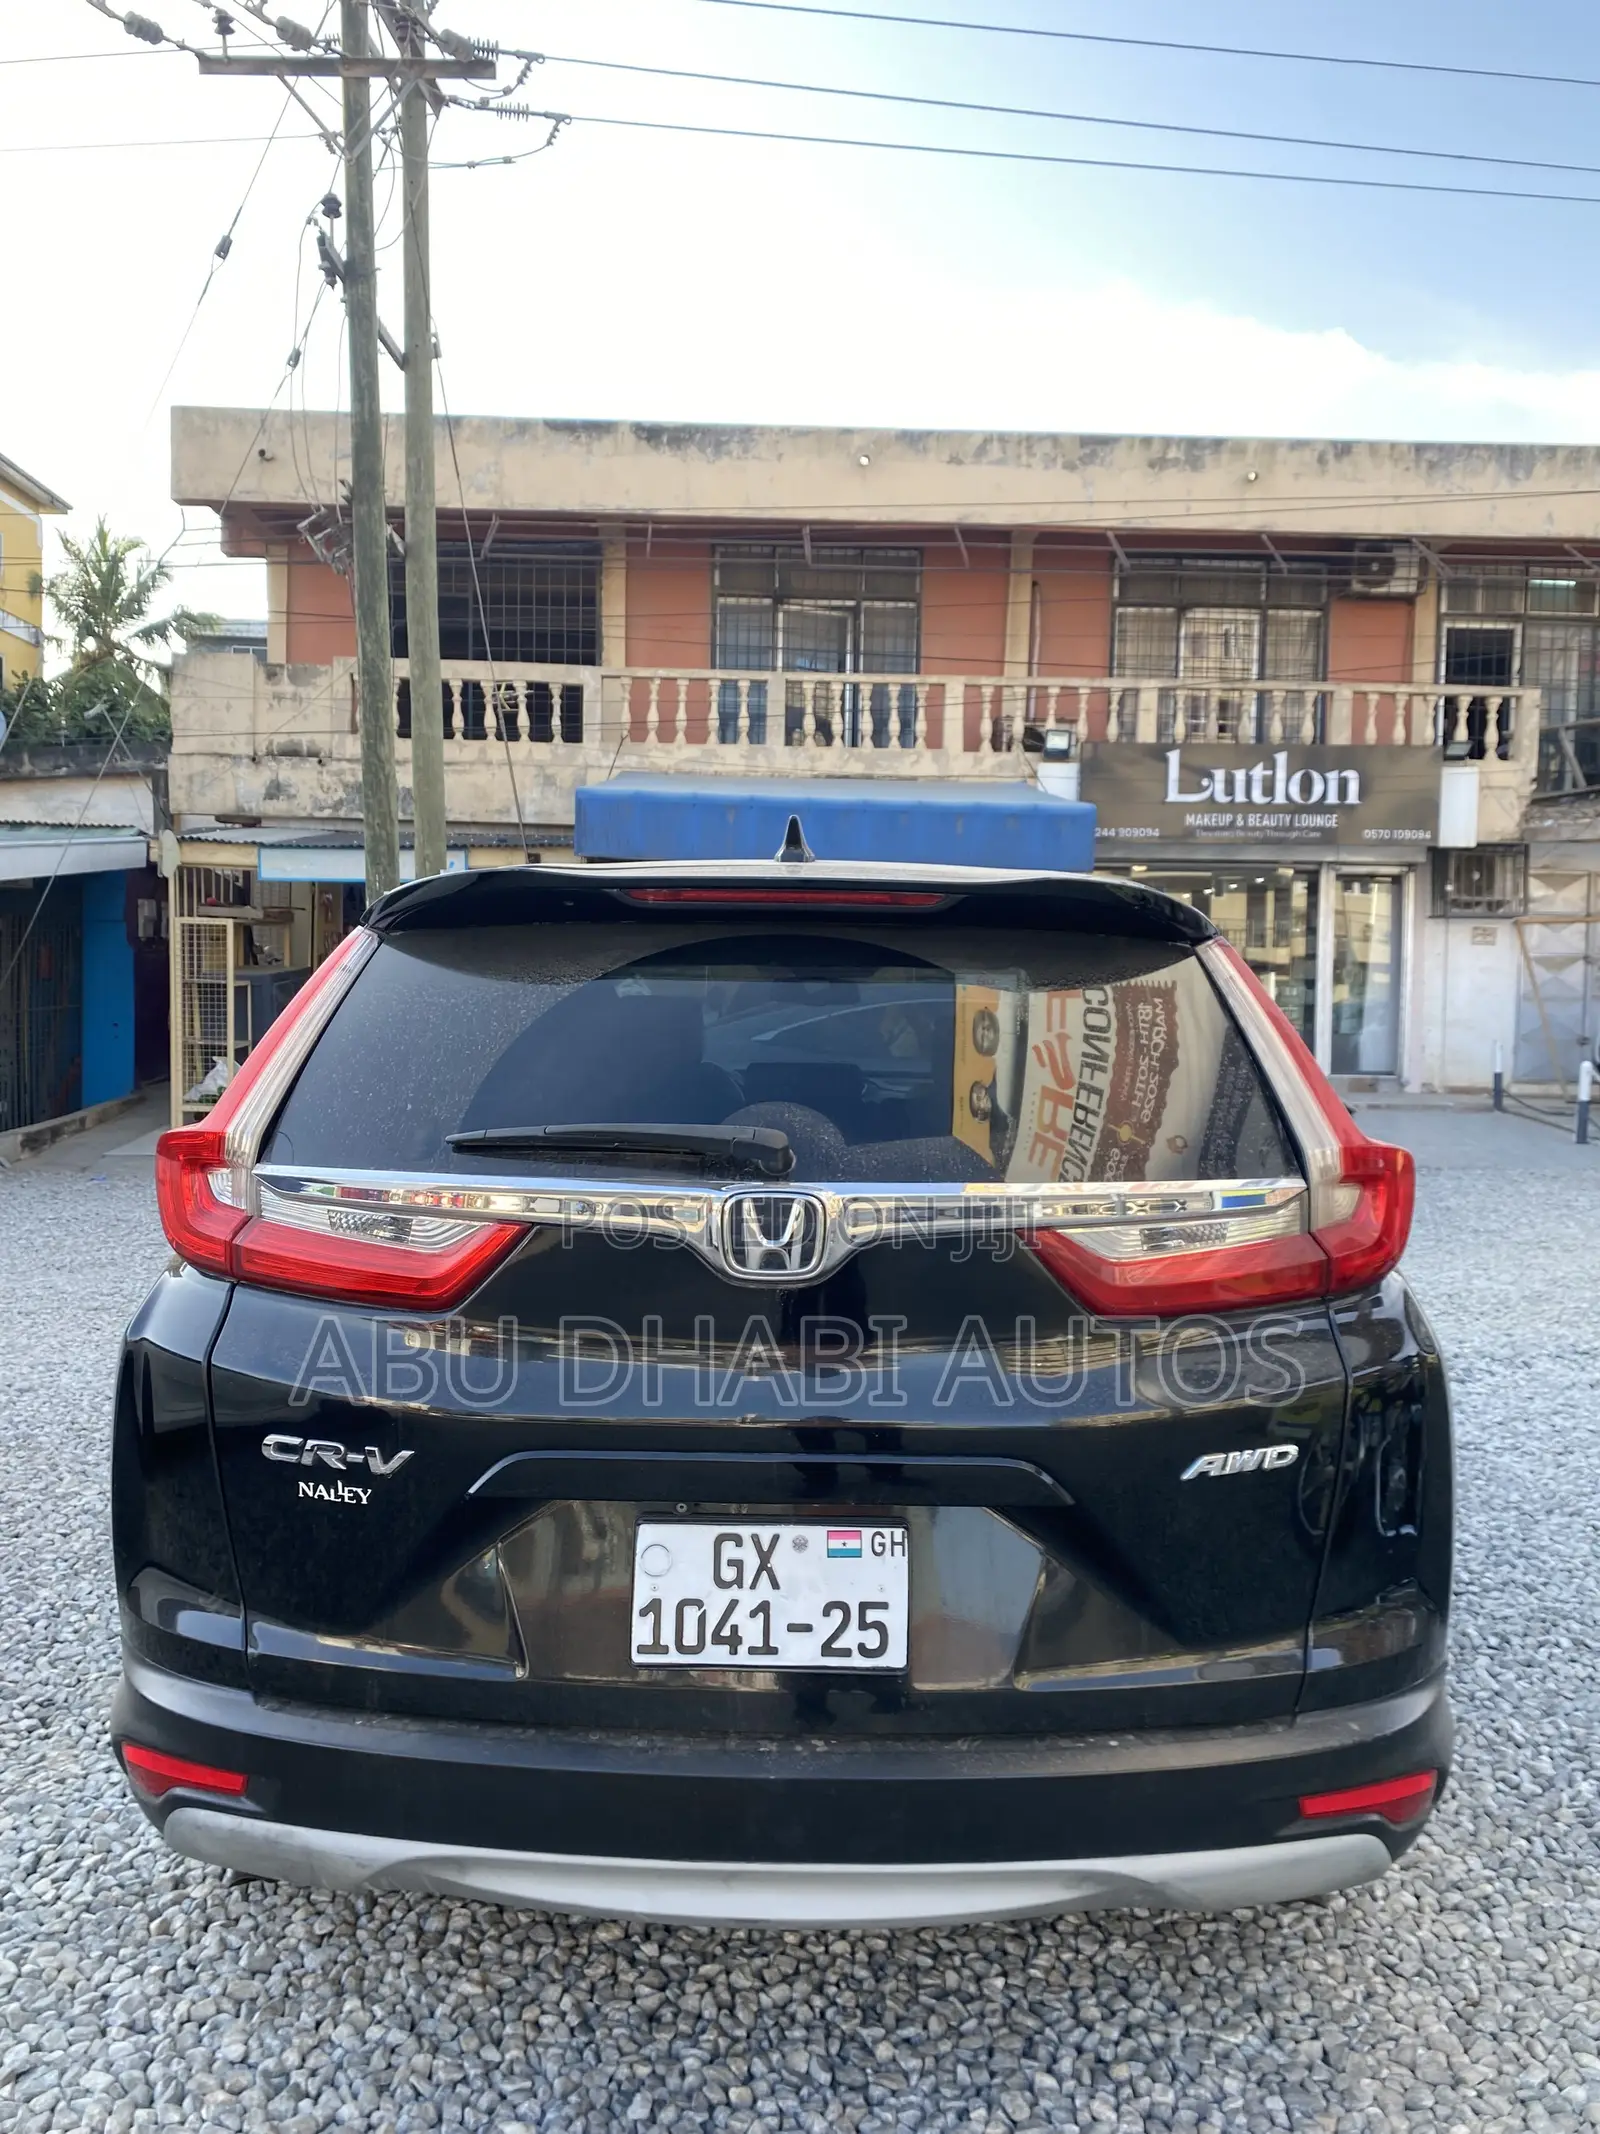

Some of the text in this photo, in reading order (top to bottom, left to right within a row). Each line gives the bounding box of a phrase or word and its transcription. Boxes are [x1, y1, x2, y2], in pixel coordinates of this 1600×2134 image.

[1165, 748, 1363, 805] Lutlon
[1185, 813, 1338, 828] MAKEUP & BEAUTY LOUNGE
[1363, 829, 1391, 840] 0570
[261, 1433, 415, 1478] CR-V
[1180, 1444, 1299, 1481] AWD
[298, 1479, 372, 1505] NALLEY
[713, 1532, 780, 1590] GX
[871, 1530, 907, 1557] GH
[636, 1597, 889, 1659] 1041-25
